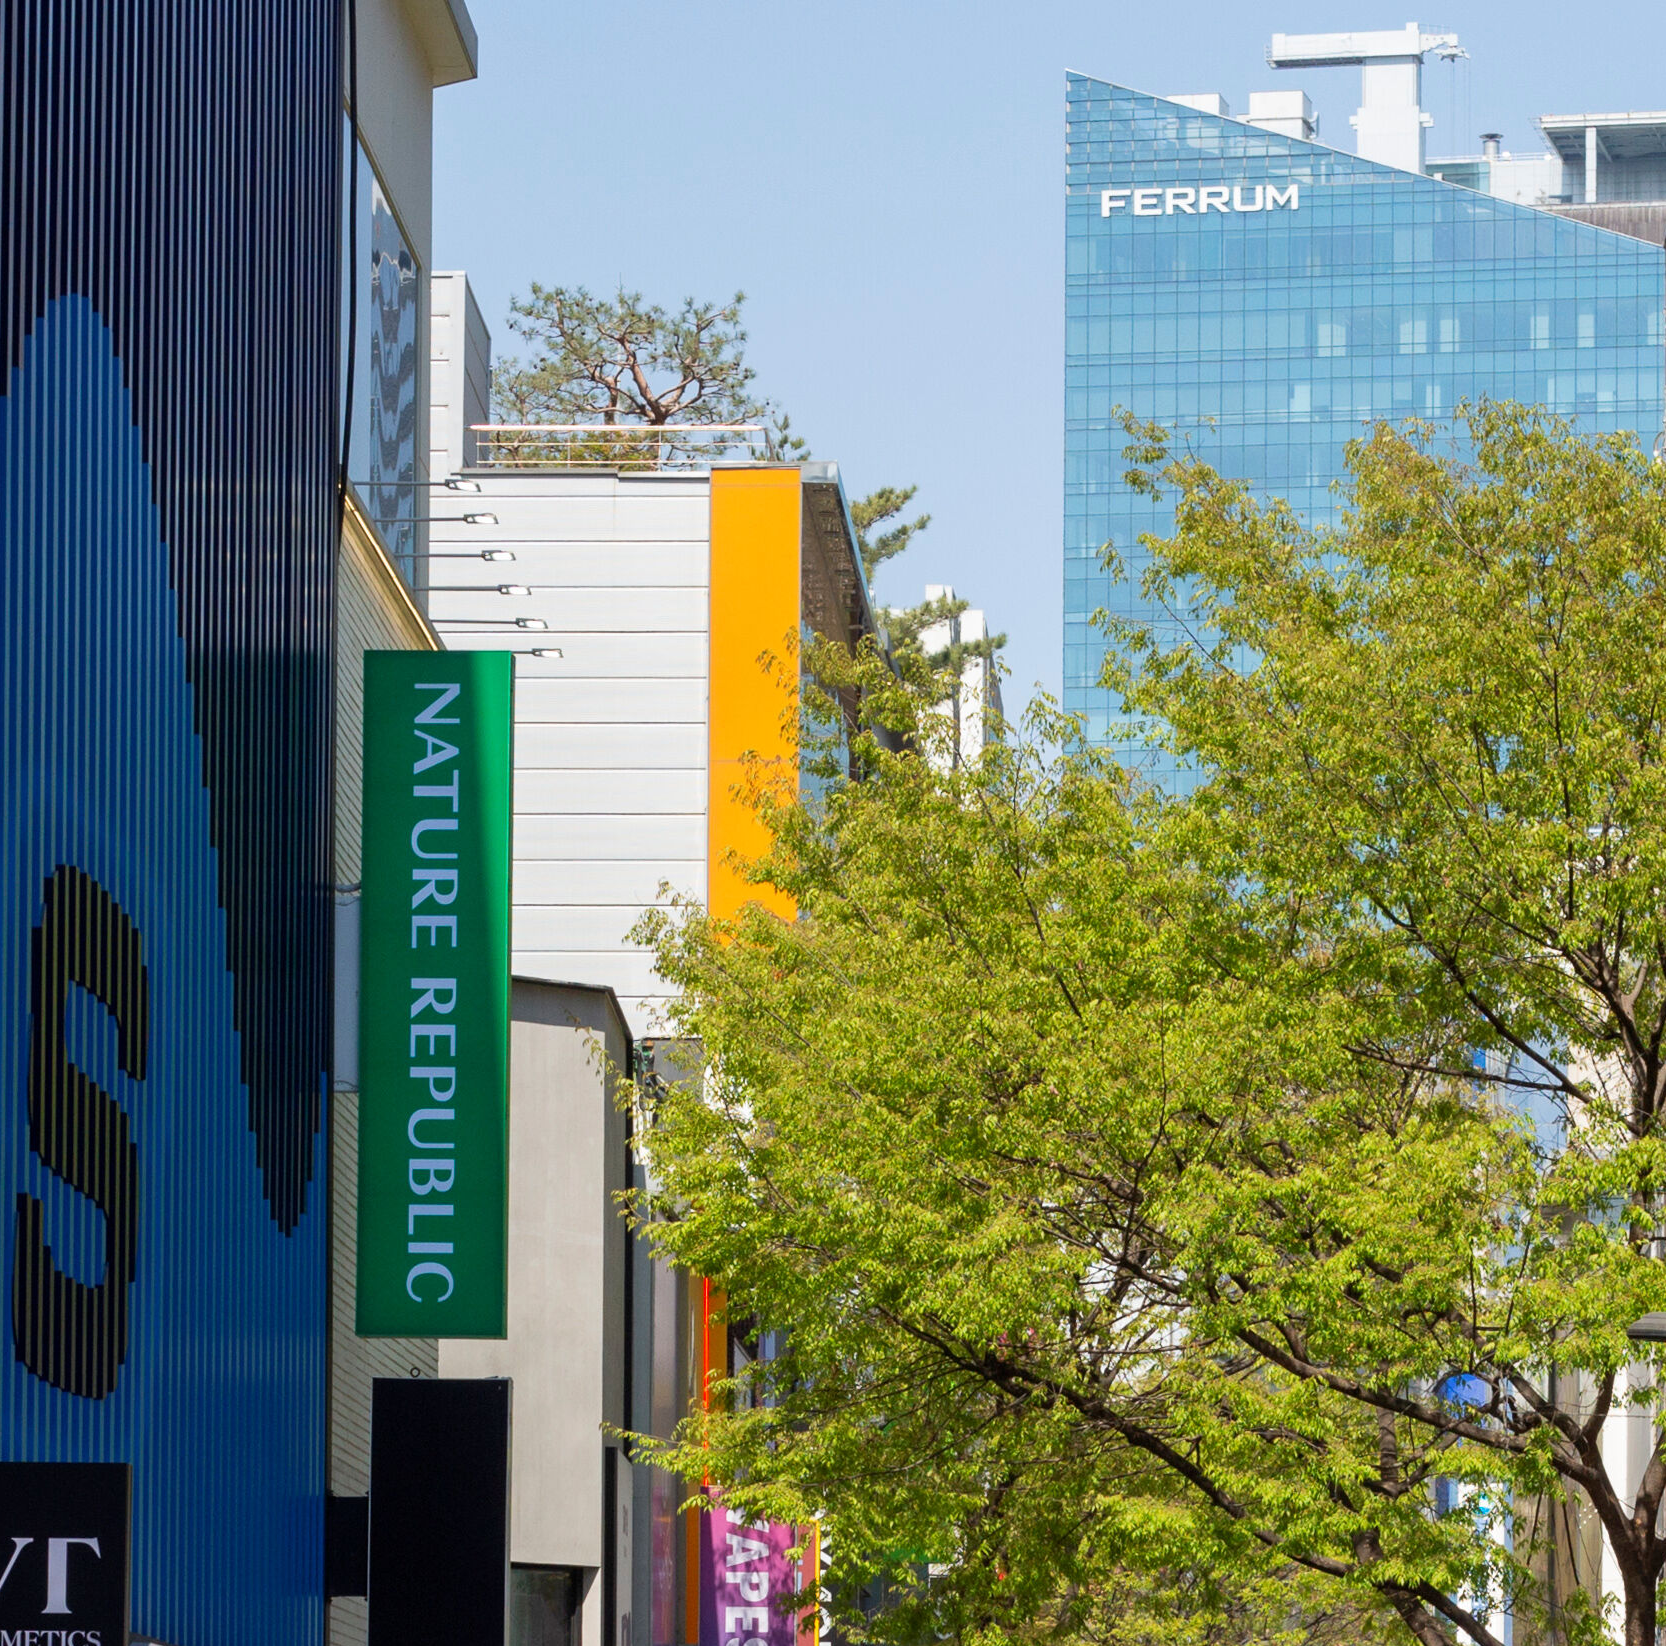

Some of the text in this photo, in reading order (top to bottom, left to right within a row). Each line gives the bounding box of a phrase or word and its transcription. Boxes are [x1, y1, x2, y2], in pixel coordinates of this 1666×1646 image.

[1101, 184, 1299, 218] FERRUM
[406, 683, 461, 1304] NATURE REPUBLIC
